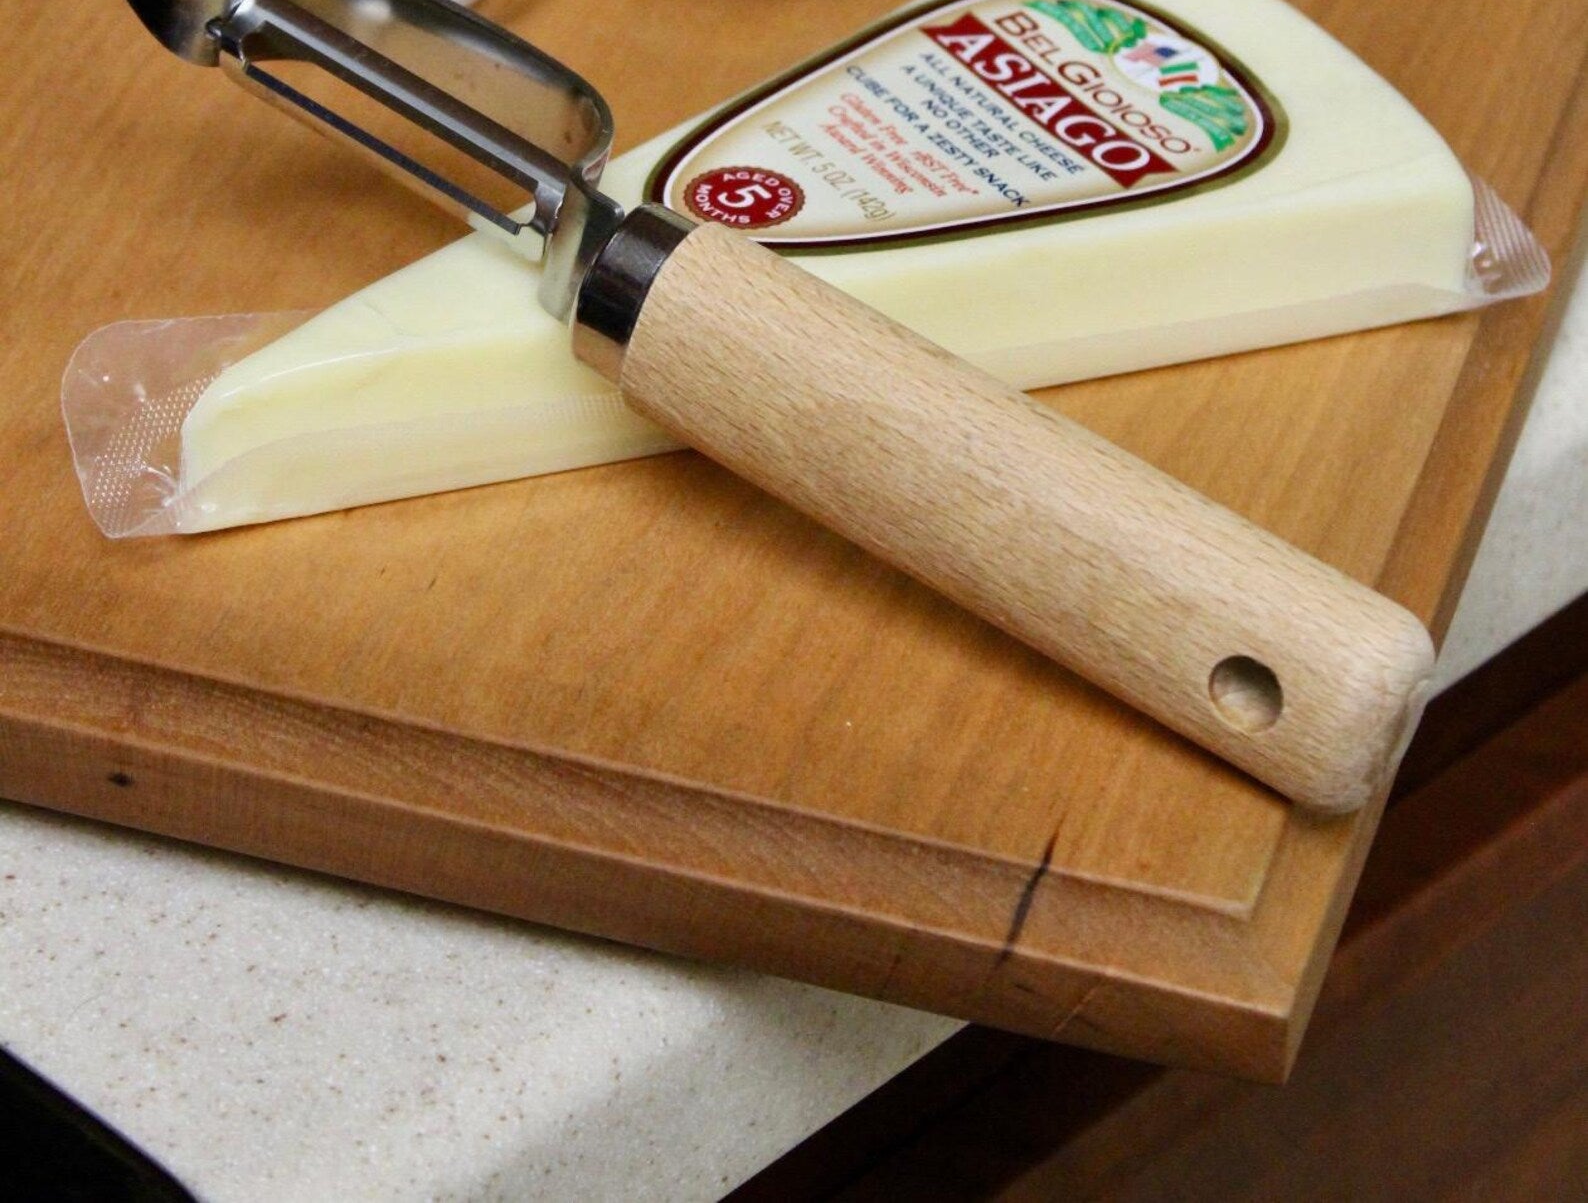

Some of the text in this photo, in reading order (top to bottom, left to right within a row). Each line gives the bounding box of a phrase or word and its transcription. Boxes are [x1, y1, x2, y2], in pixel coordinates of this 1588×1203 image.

[901, 65, 1058, 181] A UNIQUE TASTE LIKE
[917, 52, 1086, 175] ALL NATURAL CHEESE
[921, 99, 1000, 159] NO OTHER
[936, 33, 1151, 171] ASIAGO
[846, 65, 1030, 208] CUBE FOR A ZESTY SNACK
[717, 184, 772, 208] 5
[723, 171, 794, 218] AGED OVER
[869, 139, 888, 152] in
[886, 151, 948, 198] Wisconsin
[695, 183, 751, 223] MONTHS
[840, 189, 898, 223] (142g)
